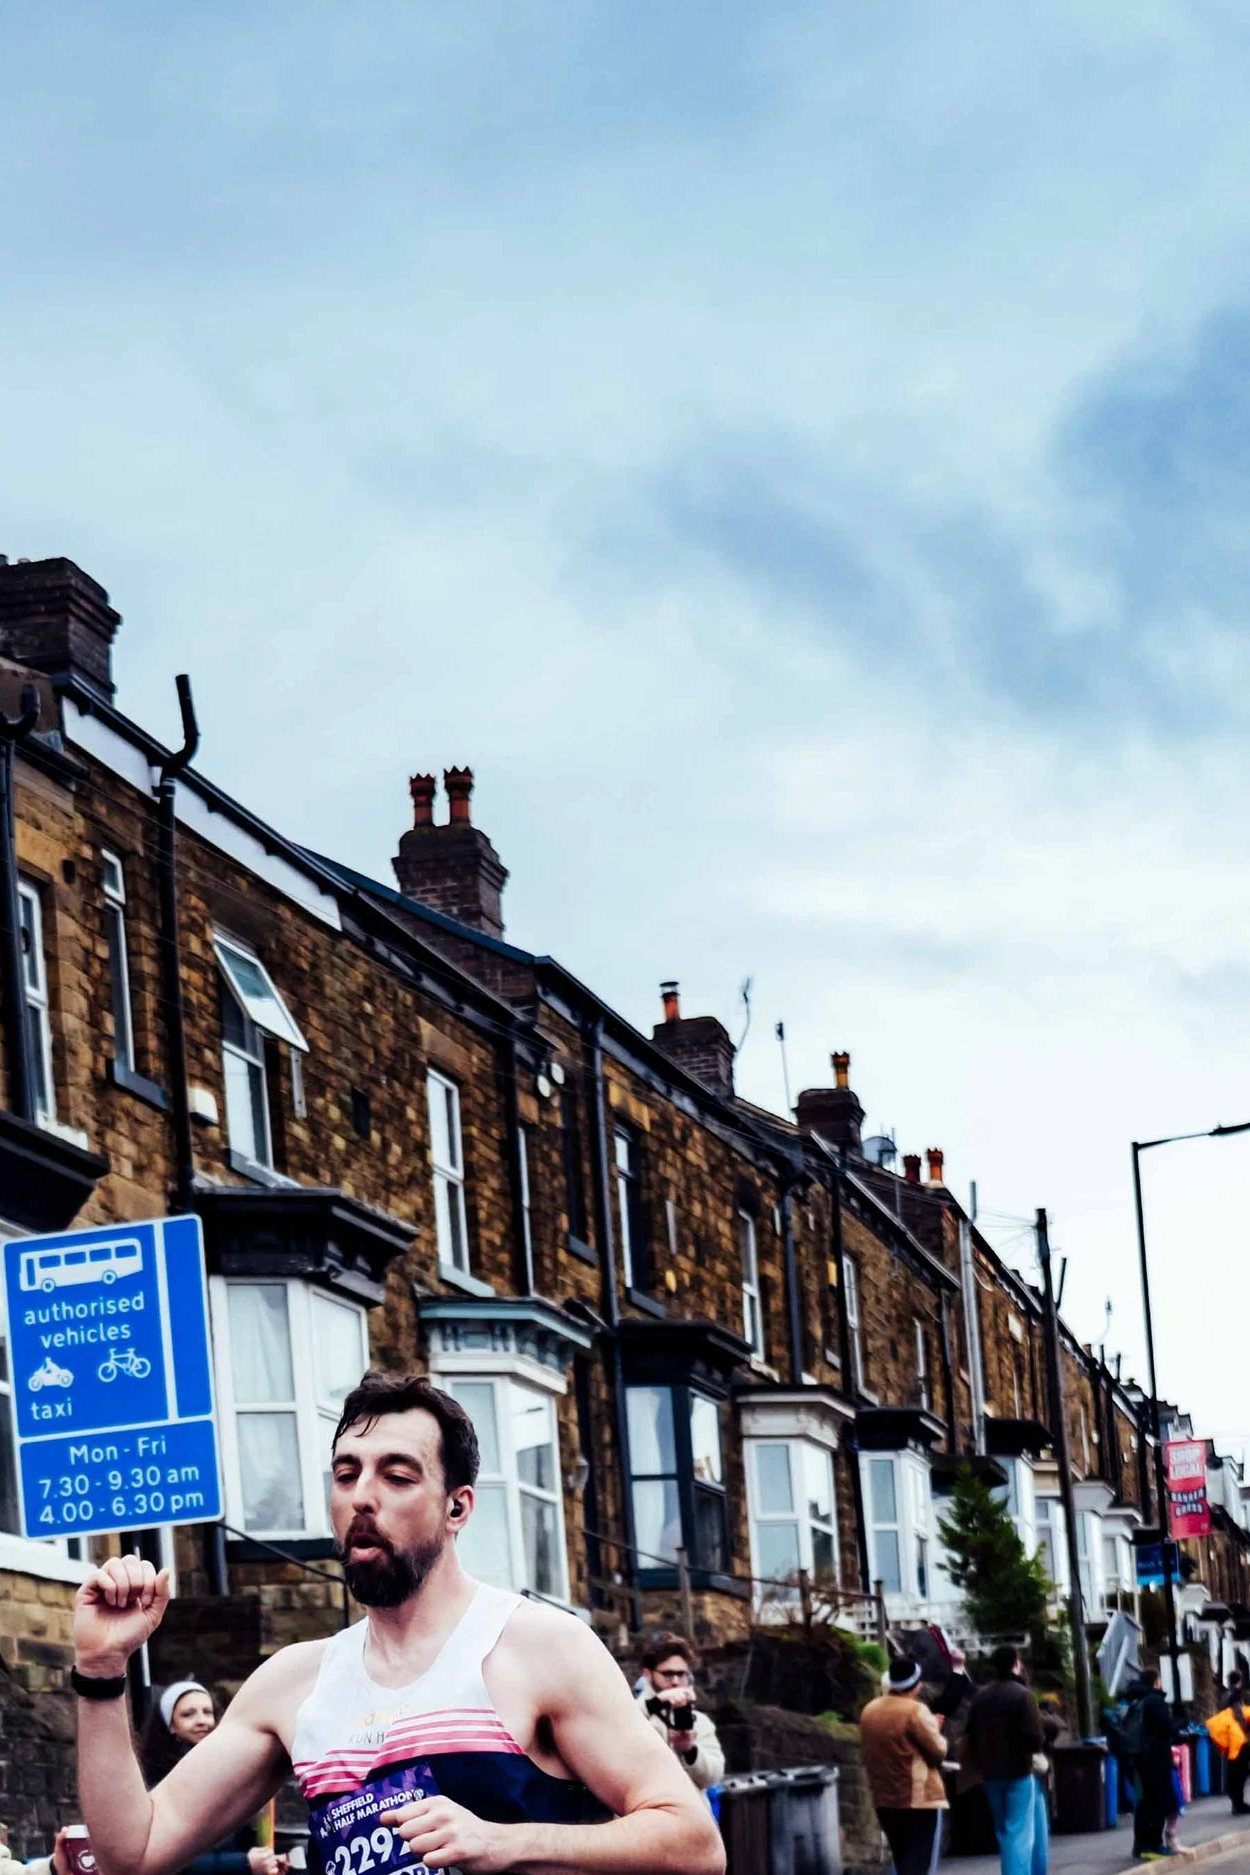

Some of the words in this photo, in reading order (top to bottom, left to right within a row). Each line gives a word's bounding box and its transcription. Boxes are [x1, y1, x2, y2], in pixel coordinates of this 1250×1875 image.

[24, 1291, 145, 1326] authorised
[39, 1323, 132, 1349] vehicles
[30, 1398, 73, 1420] taxi
[69, 1444, 118, 1466] Mon
[137, 1435, 167, 1457] Fri
[39, 1474, 90, 1500] 7.30
[109, 1466, 161, 1491] 9.30
[167, 1465, 199, 1484] am
[39, 1500, 93, 1525] 4.00
[112, 1491, 164, 1517] 6.30
[170, 1491, 204, 1515] pm
[331, 1792, 375, 1819] SHEFFIELD
[333, 1813, 356, 1831] HALF
[357, 1790, 416, 1820] MARATHON
